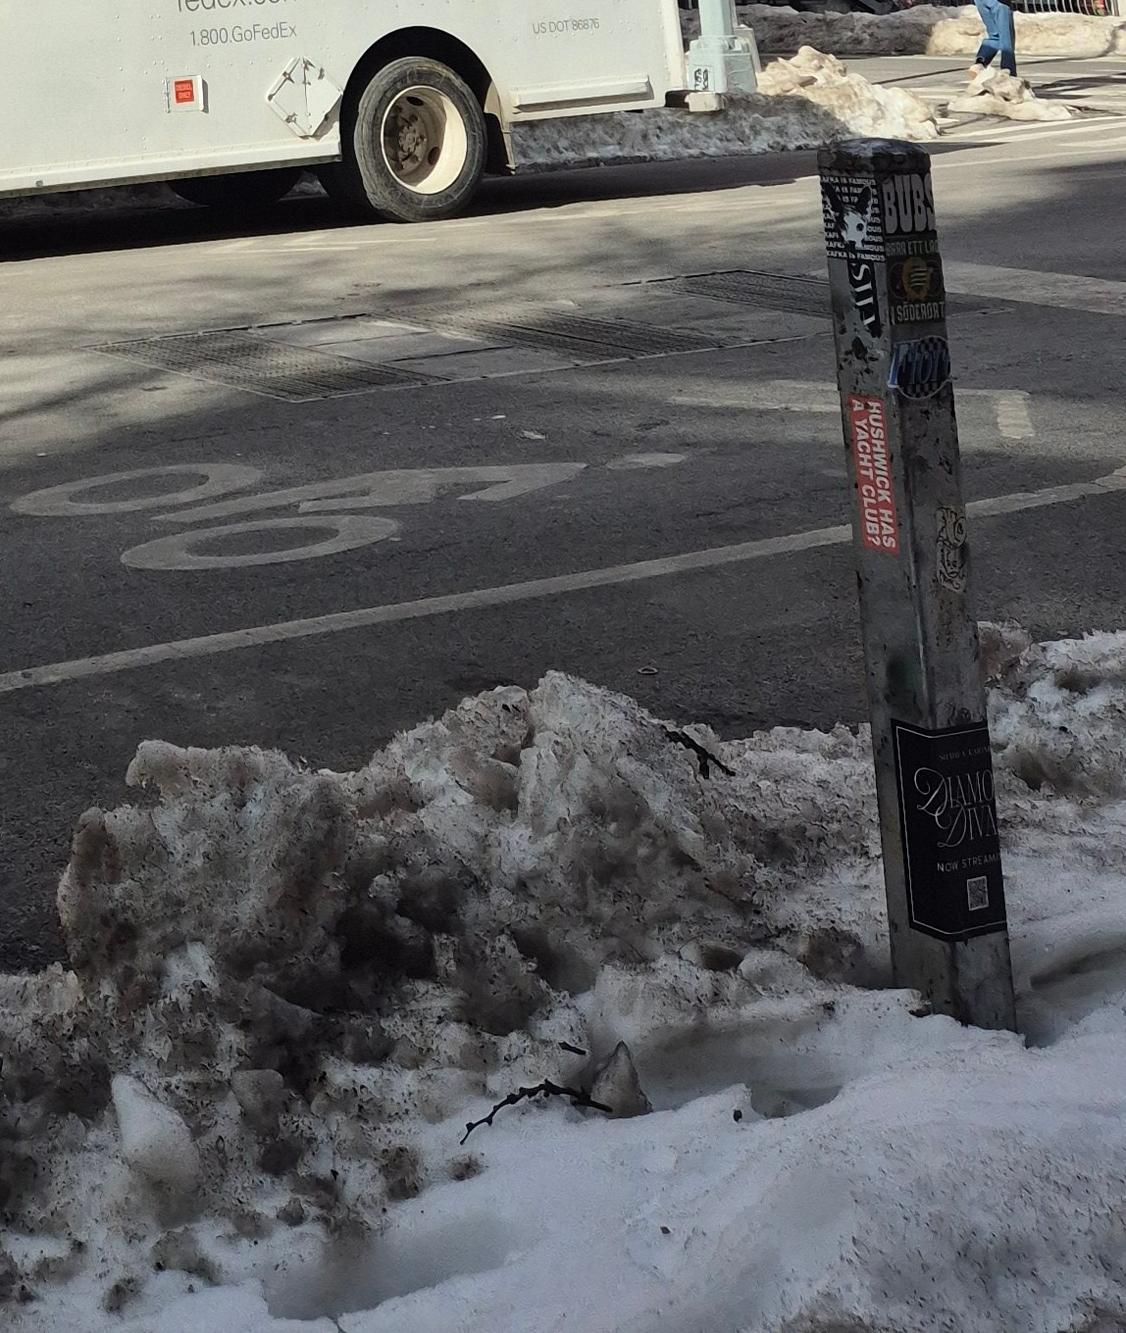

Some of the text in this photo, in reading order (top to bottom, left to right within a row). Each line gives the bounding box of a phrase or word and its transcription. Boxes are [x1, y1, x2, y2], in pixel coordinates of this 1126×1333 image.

[190, 21, 298, 46] 1.800.GoFedEx
[532, 18, 600, 34] US DOT 86876
[882, 173, 936, 234] BUBS
[852, 399, 881, 547] A YACHT CLUB?
[879, 508, 896, 549] HAS
[936, 860, 959, 873] NOW
